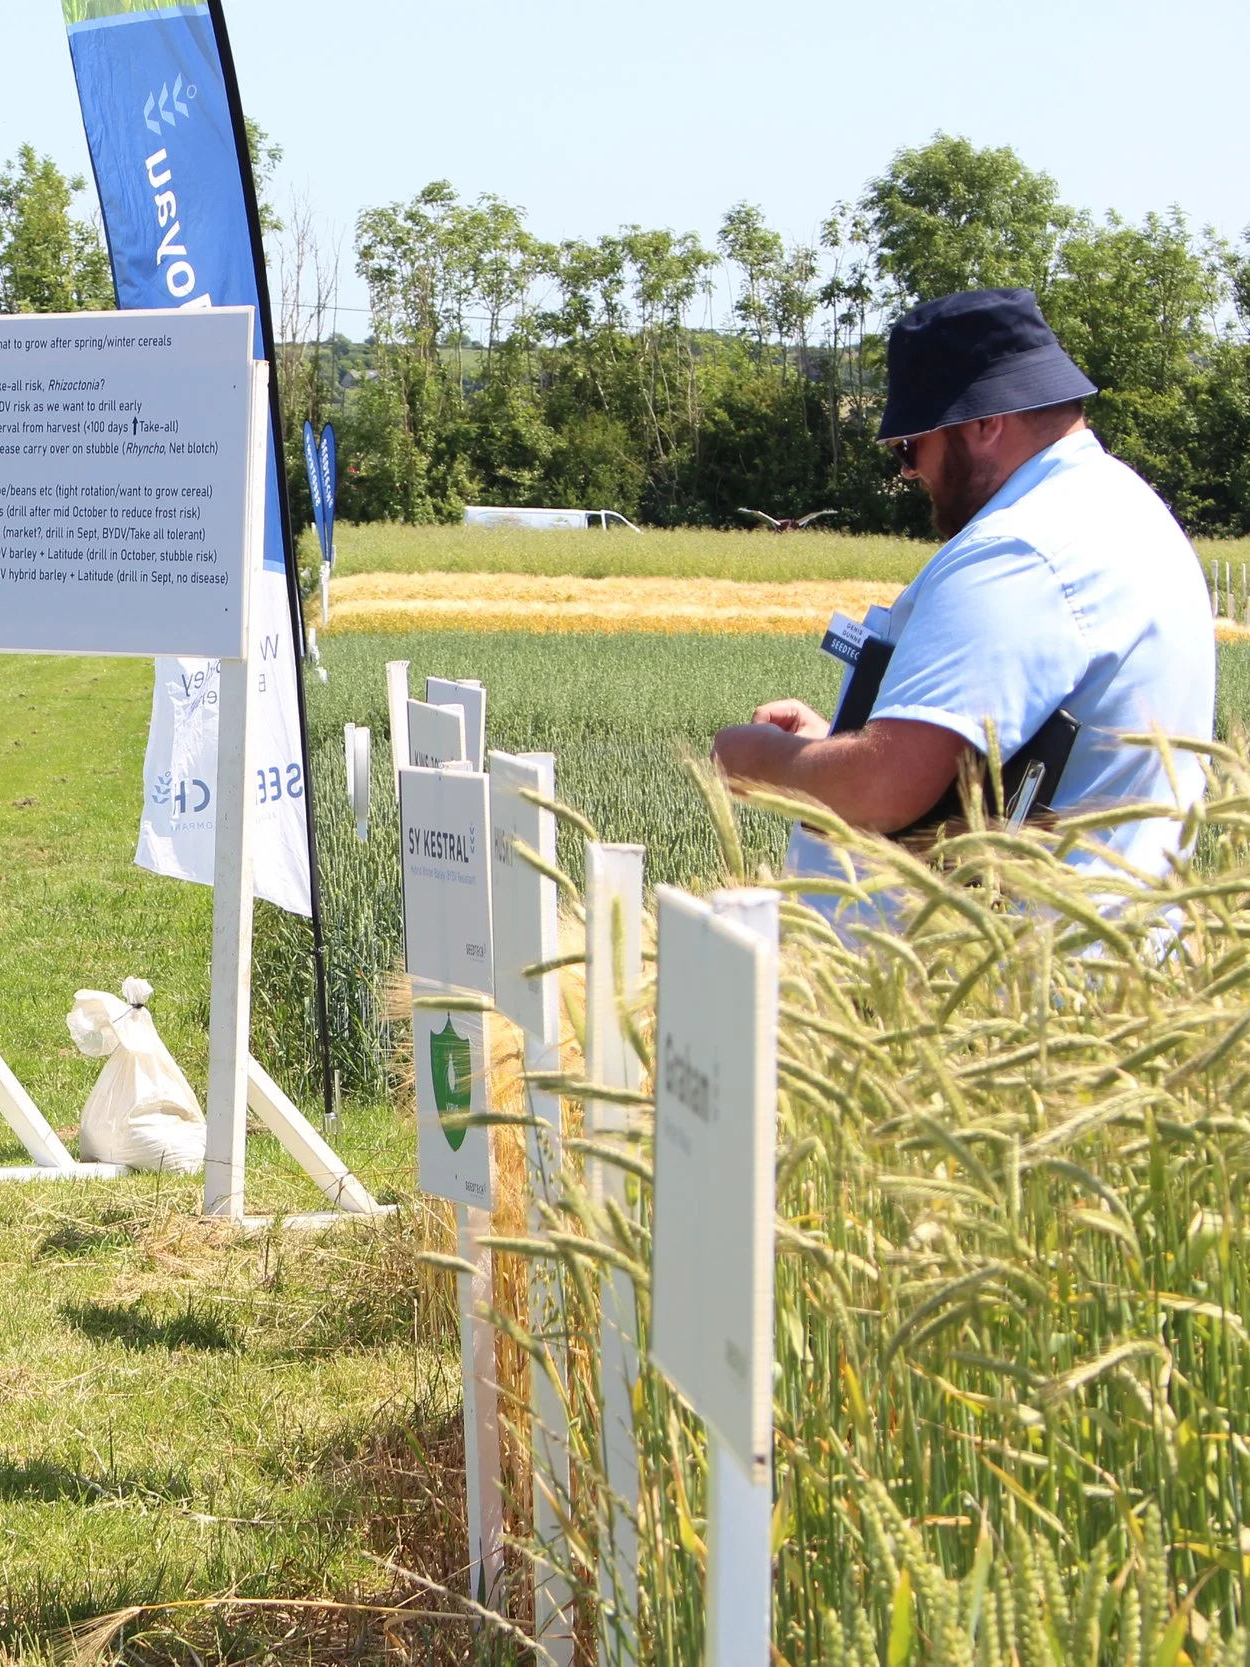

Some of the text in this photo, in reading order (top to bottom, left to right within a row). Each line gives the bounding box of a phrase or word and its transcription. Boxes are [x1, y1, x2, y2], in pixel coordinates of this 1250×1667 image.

[13, 338, 22, 349] to
[24, 339, 47, 352] grow
[50, 336, 72, 348] after
[74, 334, 135, 351] spring/winter
[137, 334, 171, 347] cereals
[24, 379, 44, 392] risk,
[48, 378, 105, 391] Rhizoctonia?
[13, 400, 30, 412] risk
[33, 403, 43, 412] as
[46, 402, 59, 412] we
[62, 400, 84, 411] want
[86, 400, 95, 411] to
[98, 399, 116, 411] drill
[118, 399, 142, 414] early
[22, 421, 43, 433] from
[46, 421, 80, 433] harvest
[107, 420, 128, 435] days
[139, 419, 178, 433] Take-all)
[22, 444, 47, 456] carry
[49, 444, 70, 454] over
[72, 445, 83, 454] on
[85, 442, 118, 454] stubble
[121, 441, 166, 456] (Rhyncho,
[168, 442, 184, 454] Net
[187, 440, 218, 455] blotch)
[39, 485, 52, 496] etc
[55, 484, 78, 499] (tight
[80, 483, 141, 498] rotation/want
[144, 486, 152, 496] to
[155, 487, 178, 499] grow
[181, 484, 212, 498] cereal)
[6, 504, 26, 518] (drill
[29, 505, 50, 517] after
[53, 505, 69, 517] mid
[72, 505, 107, 518] October
[110, 506, 118, 518] to
[121, 506, 152, 518] reduce
[155, 506, 176, 518] frost
[179, 505, 200, 520] risk)
[2, 525, 42, 539] (market?,
[45, 526, 63, 538] drill
[66, 526, 74, 538] in
[77, 526, 99, 541] Sept,
[102, 526, 150, 541] BYDV/Take
[152, 527, 164, 539] all
[166, 527, 205, 542] tolerant)
[9, 547, 37, 562] barley
[47, 547, 83, 560] Latitude
[86, 547, 107, 562] (drill
[109, 548, 117, 560] in
[120, 548, 156, 562] October,
[159, 549, 193, 561] stubble
[196, 549, 217, 564] risk)
[8, 568, 36, 583] hybrid
[39, 568, 67, 583] barley
[77, 569, 113, 582] Latitude
[116, 568, 137, 583] (drill
[140, 570, 148, 582] in
[151, 570, 173, 586] Sept,
[176, 574, 187, 583] no
[190, 570, 228, 585] disease)
[831, 639, 860, 661] SEEDTEC
[409, 827, 469, 863] SY KESTRAL
